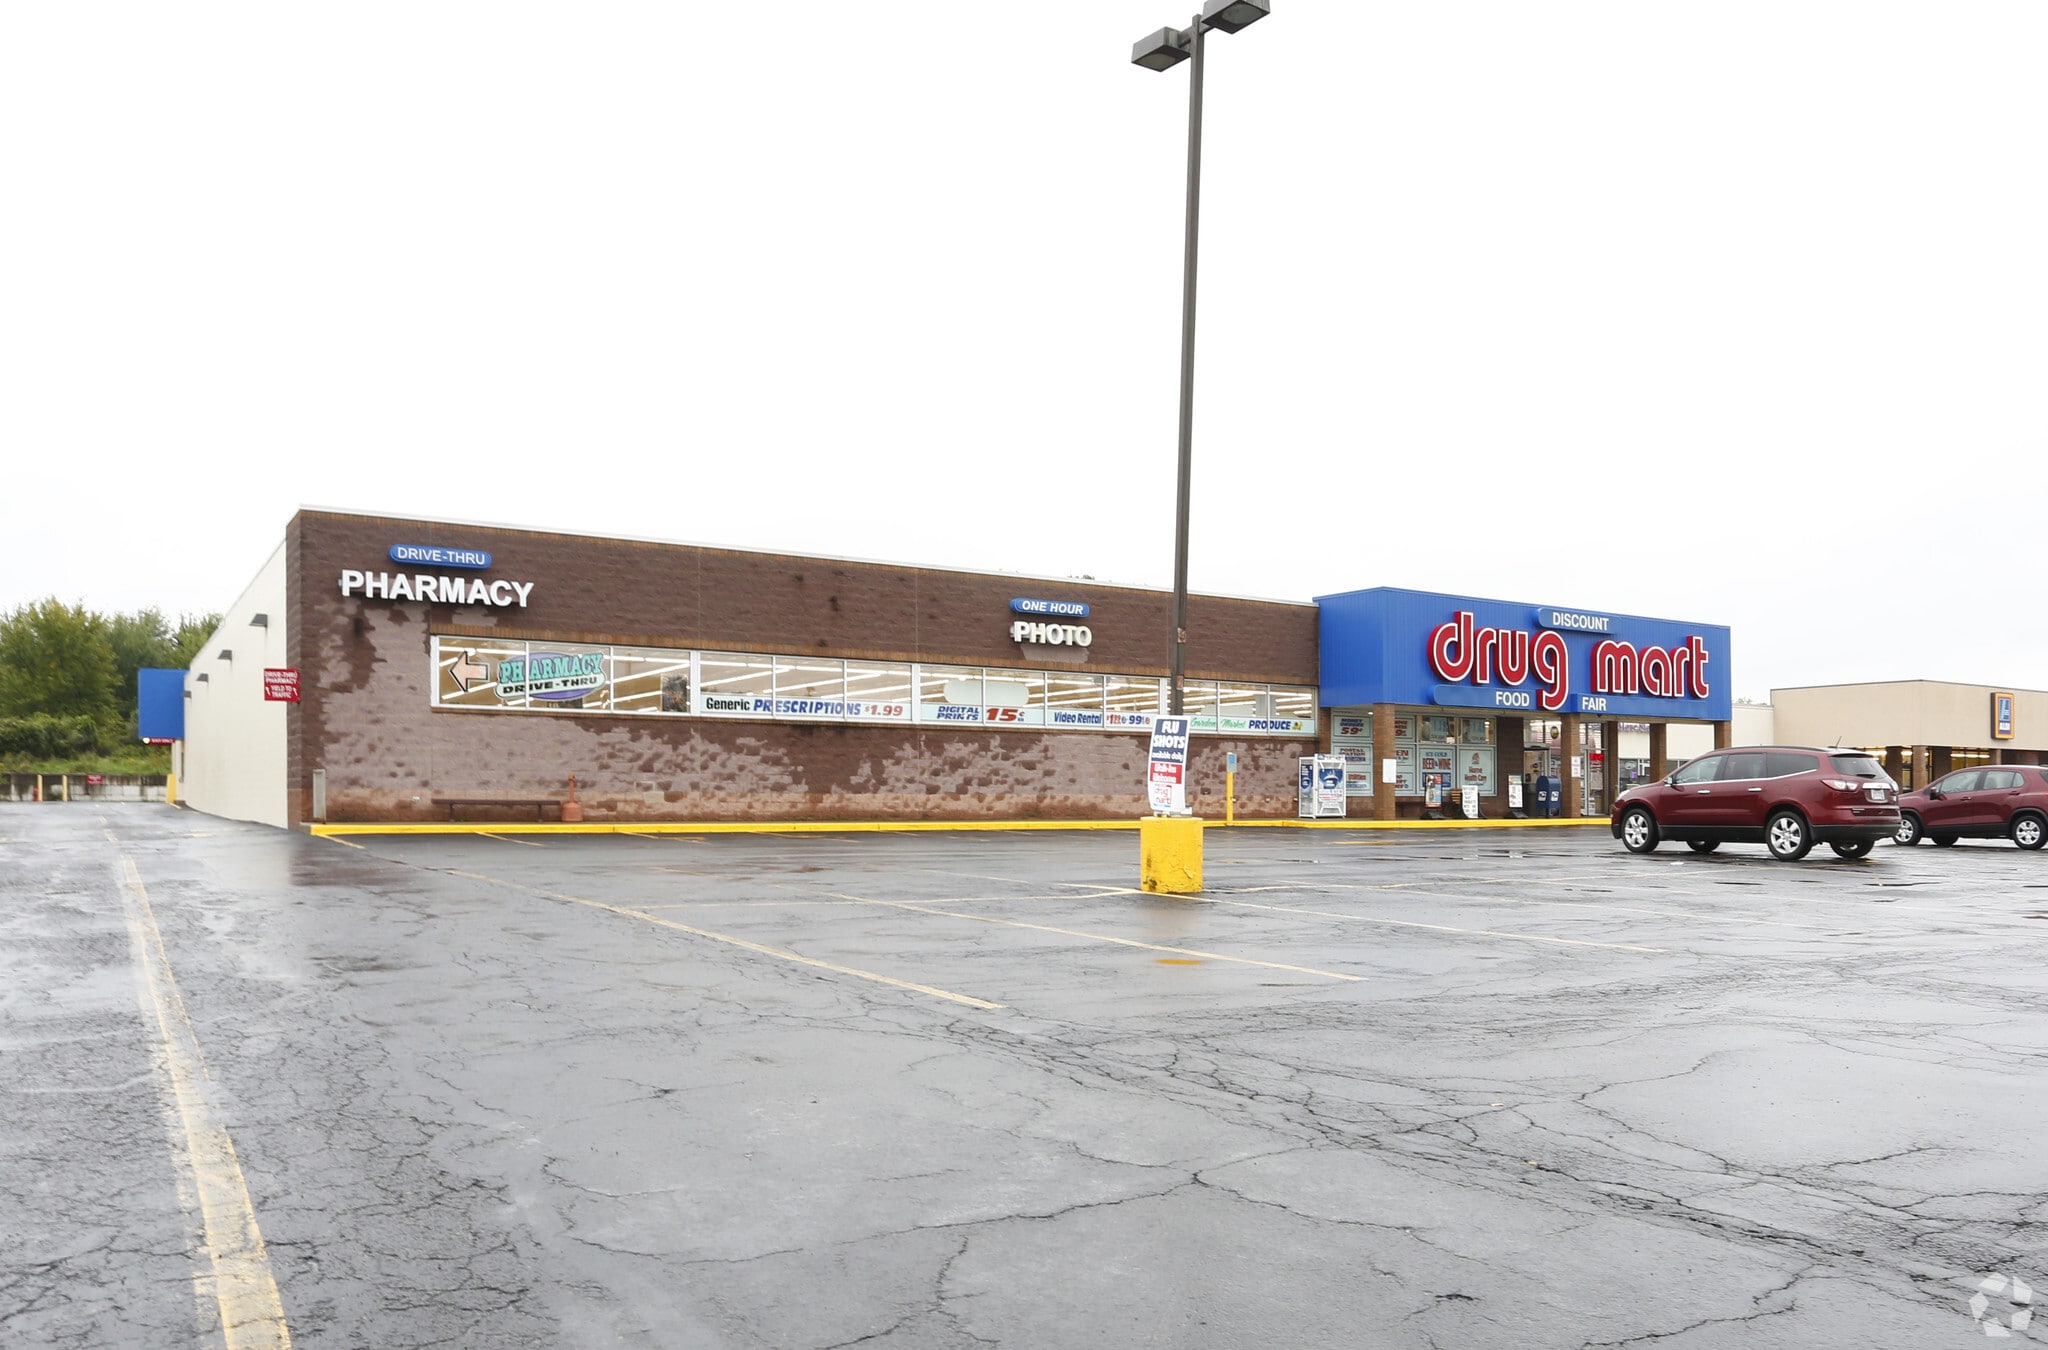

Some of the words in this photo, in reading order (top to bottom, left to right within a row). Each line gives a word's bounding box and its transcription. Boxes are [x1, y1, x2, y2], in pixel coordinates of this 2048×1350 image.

[397, 547, 486, 565] DRIVE-THRU
[341, 569, 534, 607] PHARMACY
[1022, 600, 1048, 612] ONE
[1049, 602, 1084, 615] HOUR
[1552, 611, 1610, 631] DISCOUNT
[1013, 621, 1093, 647] PHOTO
[500, 653, 604, 683] PHARMACY
[1430, 611, 1569, 711] drug
[1593, 636, 1710, 699] mart
[706, 697, 750, 711] Generic
[753, 699, 861, 715] PRESCRIPTIONS
[864, 704, 904, 716] $1.99
[938, 706, 979, 714] DIGITAL
[1495, 691, 1531, 707] FOOD
[1581, 696, 1607, 711] FAIR
[937, 712, 979, 721] PRINTS
[1054, 711, 1077, 723] Video
[1077, 713, 1102, 724] Rental
[1248, 720, 1292, 730] PRODUCE
[1161, 720, 1180, 734] FLU
[1153, 734, 1186, 749] SHOTS
